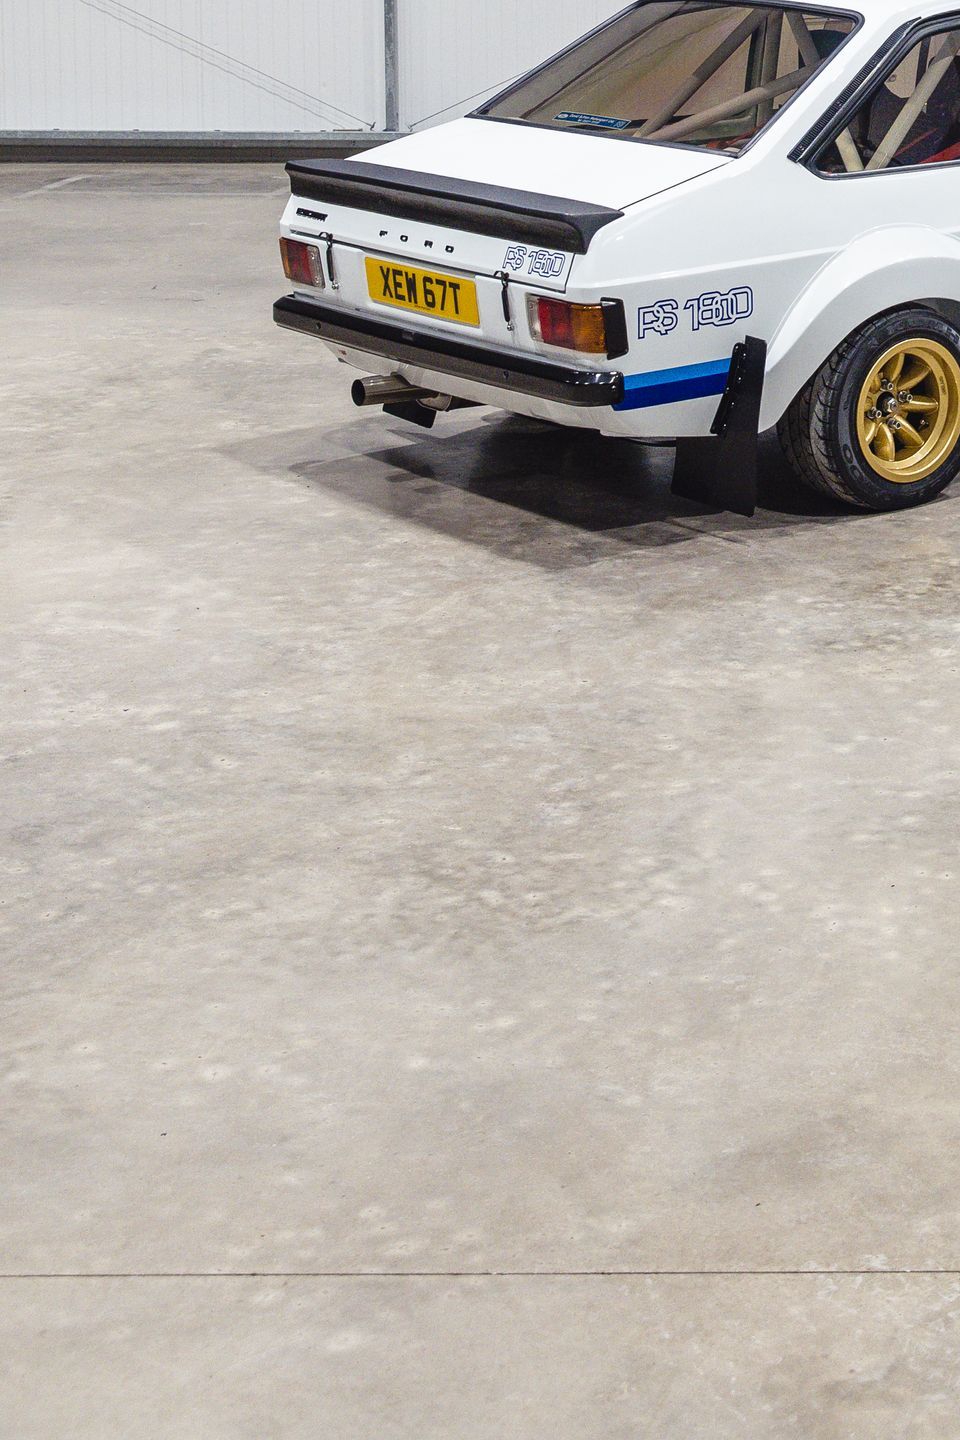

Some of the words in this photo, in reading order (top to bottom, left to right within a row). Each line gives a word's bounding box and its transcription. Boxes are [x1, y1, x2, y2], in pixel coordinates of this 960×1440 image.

[379, 230, 455, 253] FORD
[502, 246, 527, 271] RS
[379, 265, 418, 305] XEW
[422, 275, 460, 315] 67T
[638, 299, 679, 340] RS
